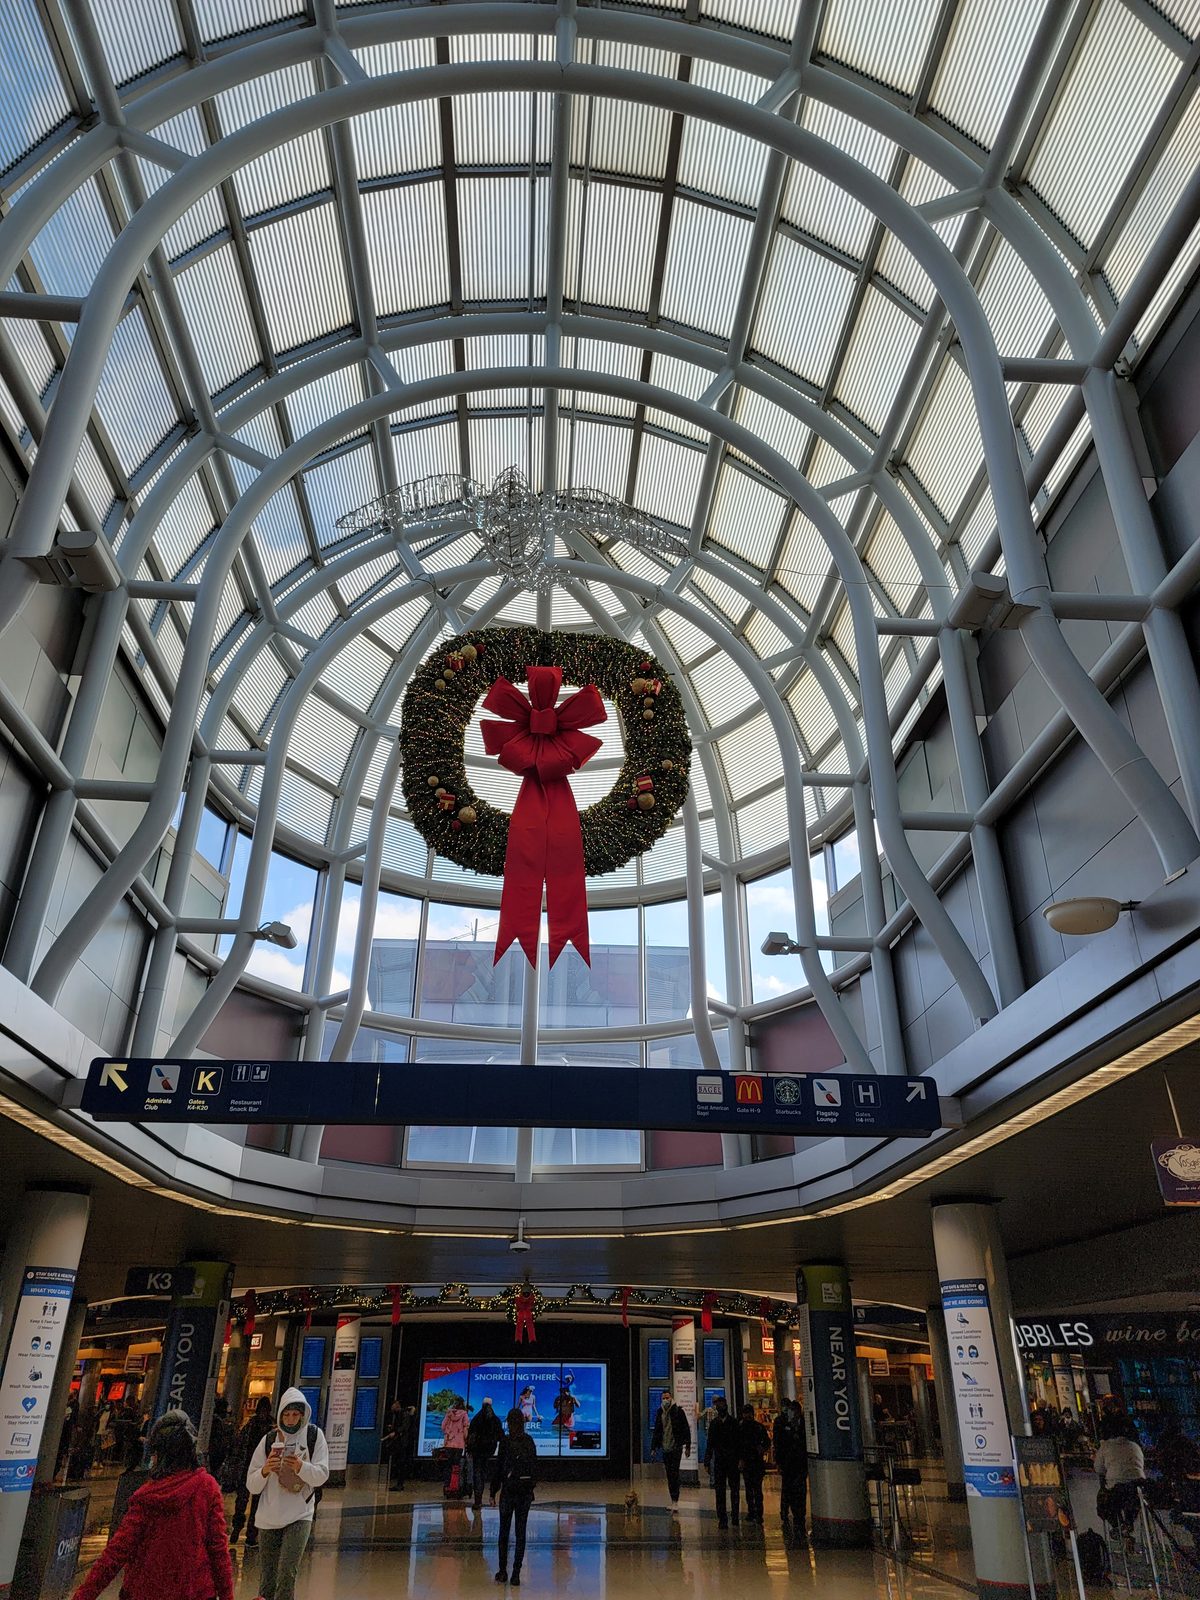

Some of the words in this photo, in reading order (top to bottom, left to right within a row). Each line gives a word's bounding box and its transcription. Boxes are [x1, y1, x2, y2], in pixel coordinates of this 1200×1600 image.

[197, 1071, 216, 1092] K
[145, 1097, 172, 1105] Admirals
[858, 1084, 875, 1104] H
[144, 1103, 158, 1111] Club
[816, 1110, 839, 1118] Flagship
[147, 1272, 173, 1290] K3
[1105, 1325, 1168, 1342] wine
[174, 1323, 195, 1367] YOU
[828, 1326, 847, 1381] NEAR
[474, 1373, 529, 1381] SNORKELING
[531, 1373, 557, 1381] THERE
[833, 1386, 851, 1431] YOU
